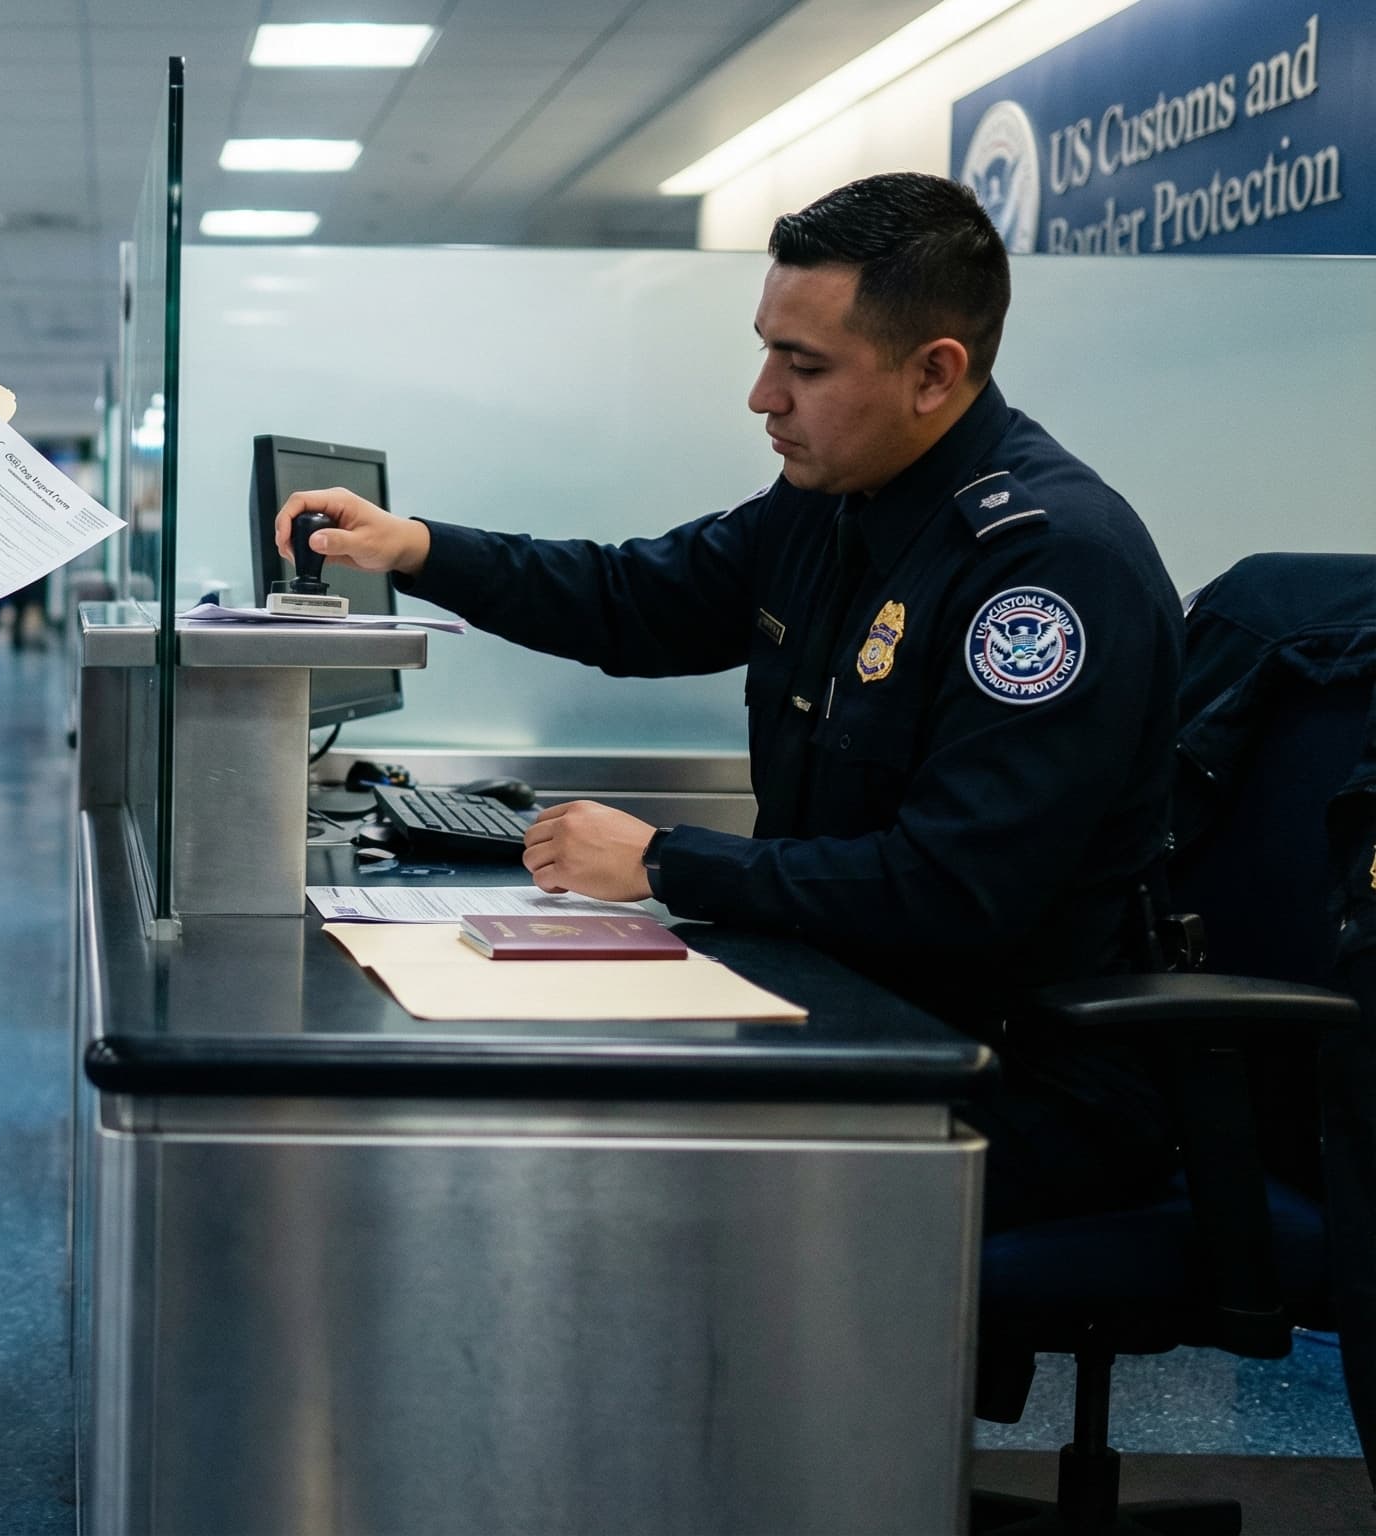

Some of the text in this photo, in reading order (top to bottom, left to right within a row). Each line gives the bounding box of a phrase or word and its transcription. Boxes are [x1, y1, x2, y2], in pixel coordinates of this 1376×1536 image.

[1049, 13, 1319, 195] US Customs and
[1151, 136, 1341, 252] Protection
